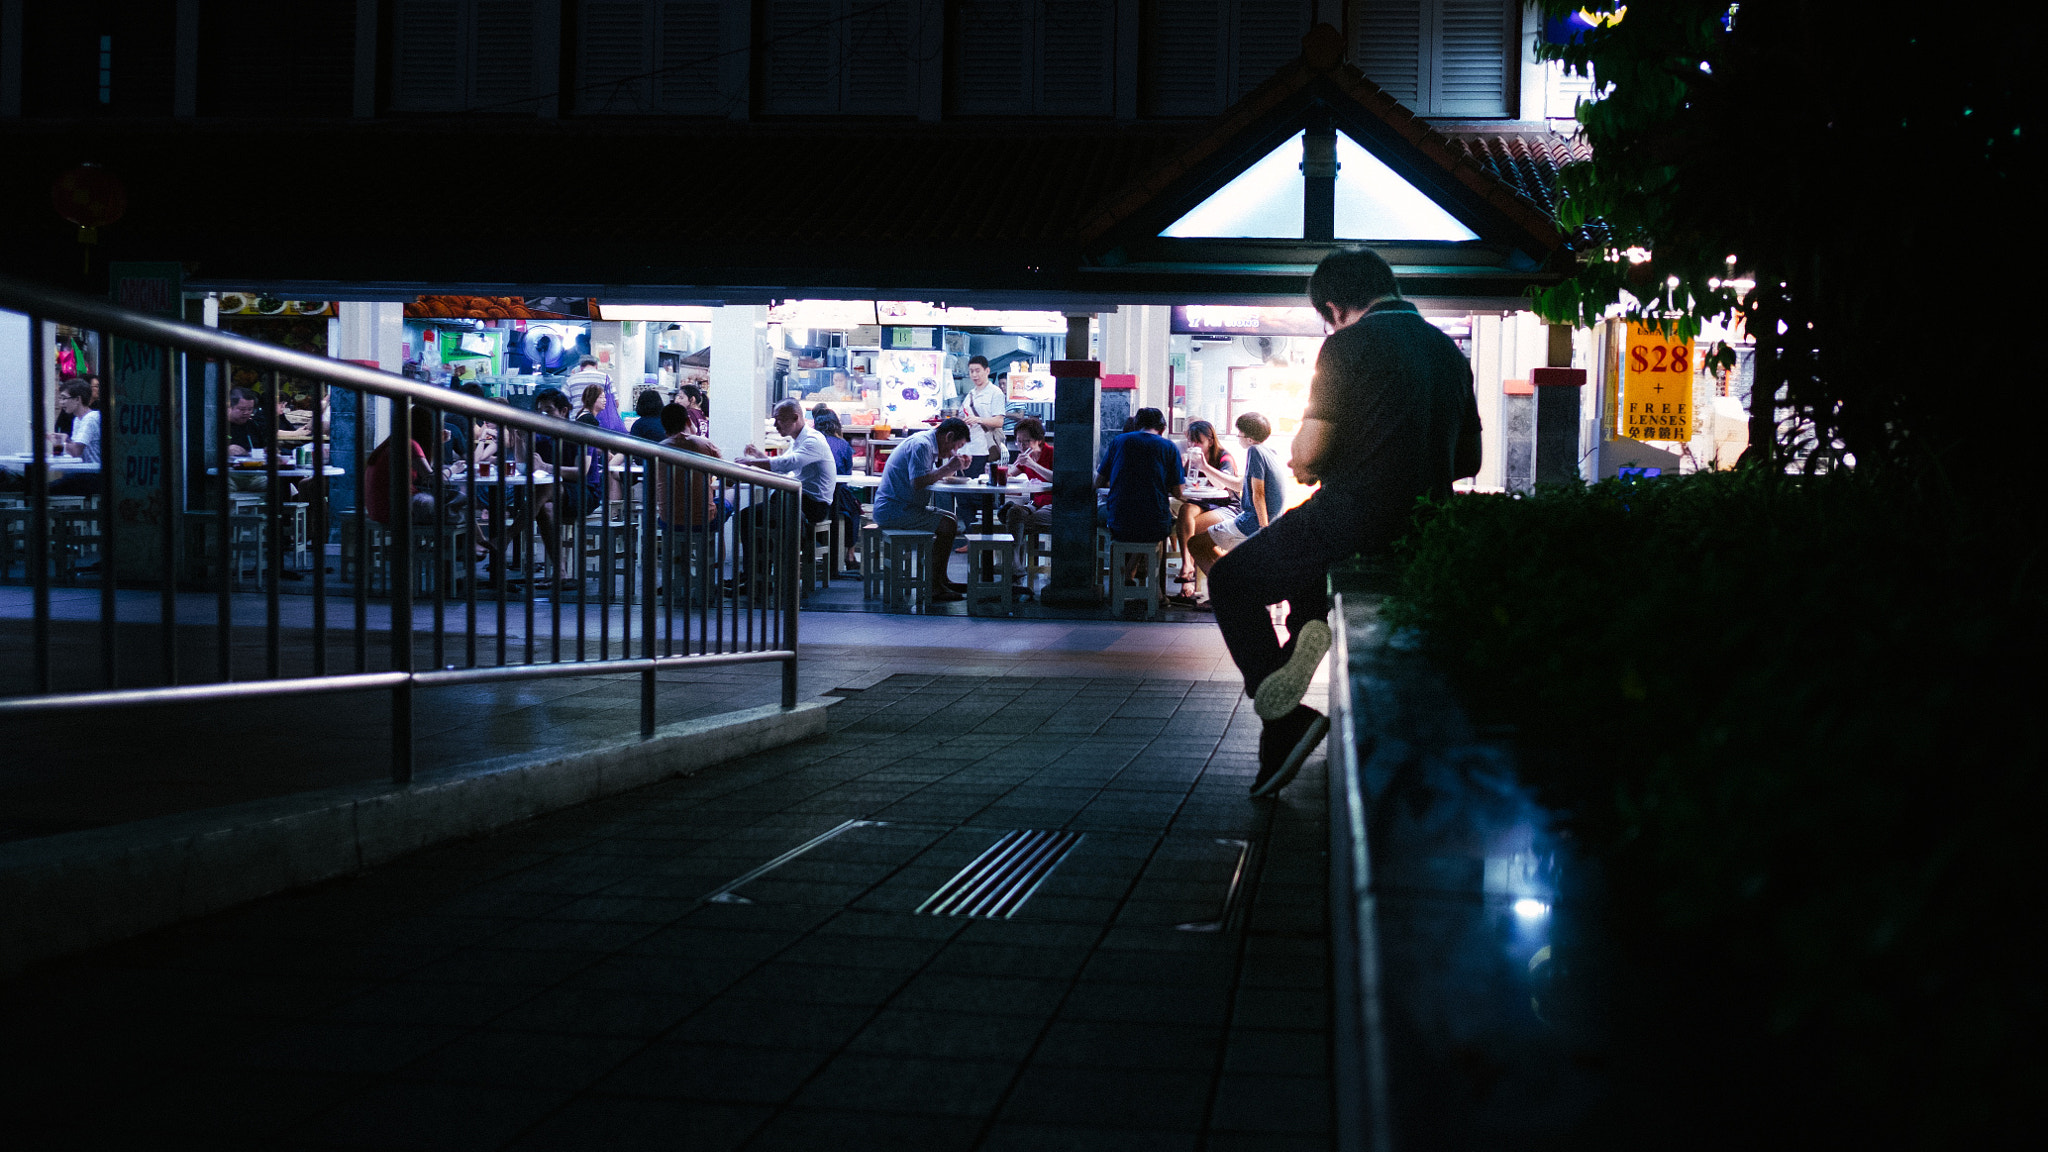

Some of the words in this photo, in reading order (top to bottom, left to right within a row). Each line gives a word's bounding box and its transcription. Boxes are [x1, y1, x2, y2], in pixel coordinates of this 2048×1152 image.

[1631, 345, 1688, 374] $28
[1654, 383, 1664, 393] +
[1630, 402, 1687, 413] FREE
[1629, 415, 1687, 426] LENSES
